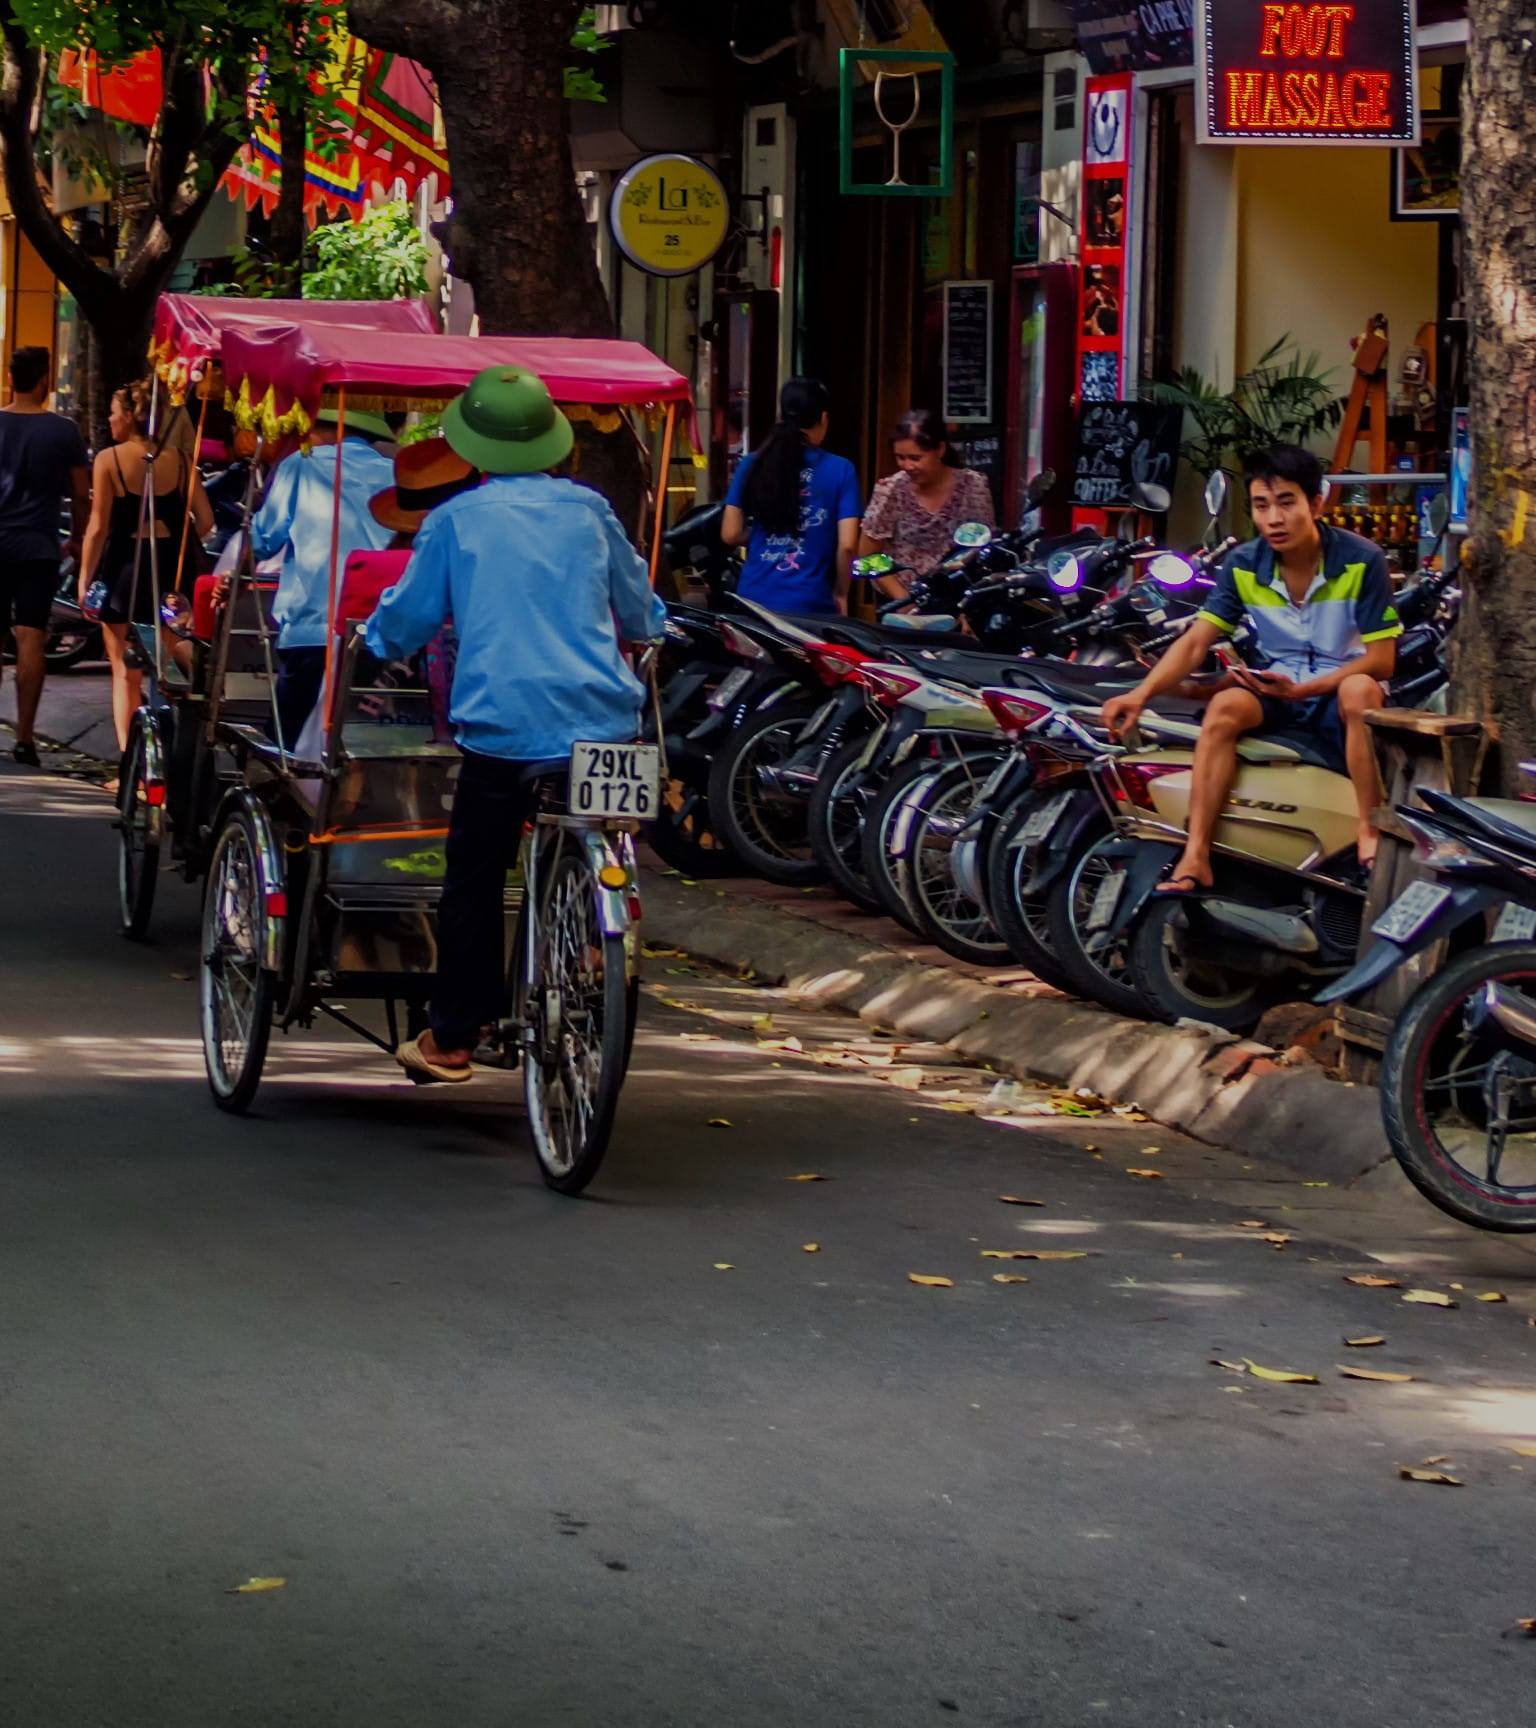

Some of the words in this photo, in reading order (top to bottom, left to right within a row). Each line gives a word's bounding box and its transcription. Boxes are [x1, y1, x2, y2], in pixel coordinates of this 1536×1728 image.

[1258, 4, 1354, 57] FOOT
[1225, 71, 1393, 129] MASSAGE
[664, 233, 681, 247] 25
[587, 747, 643, 781] 29XL
[579, 780, 649, 814] 0126
